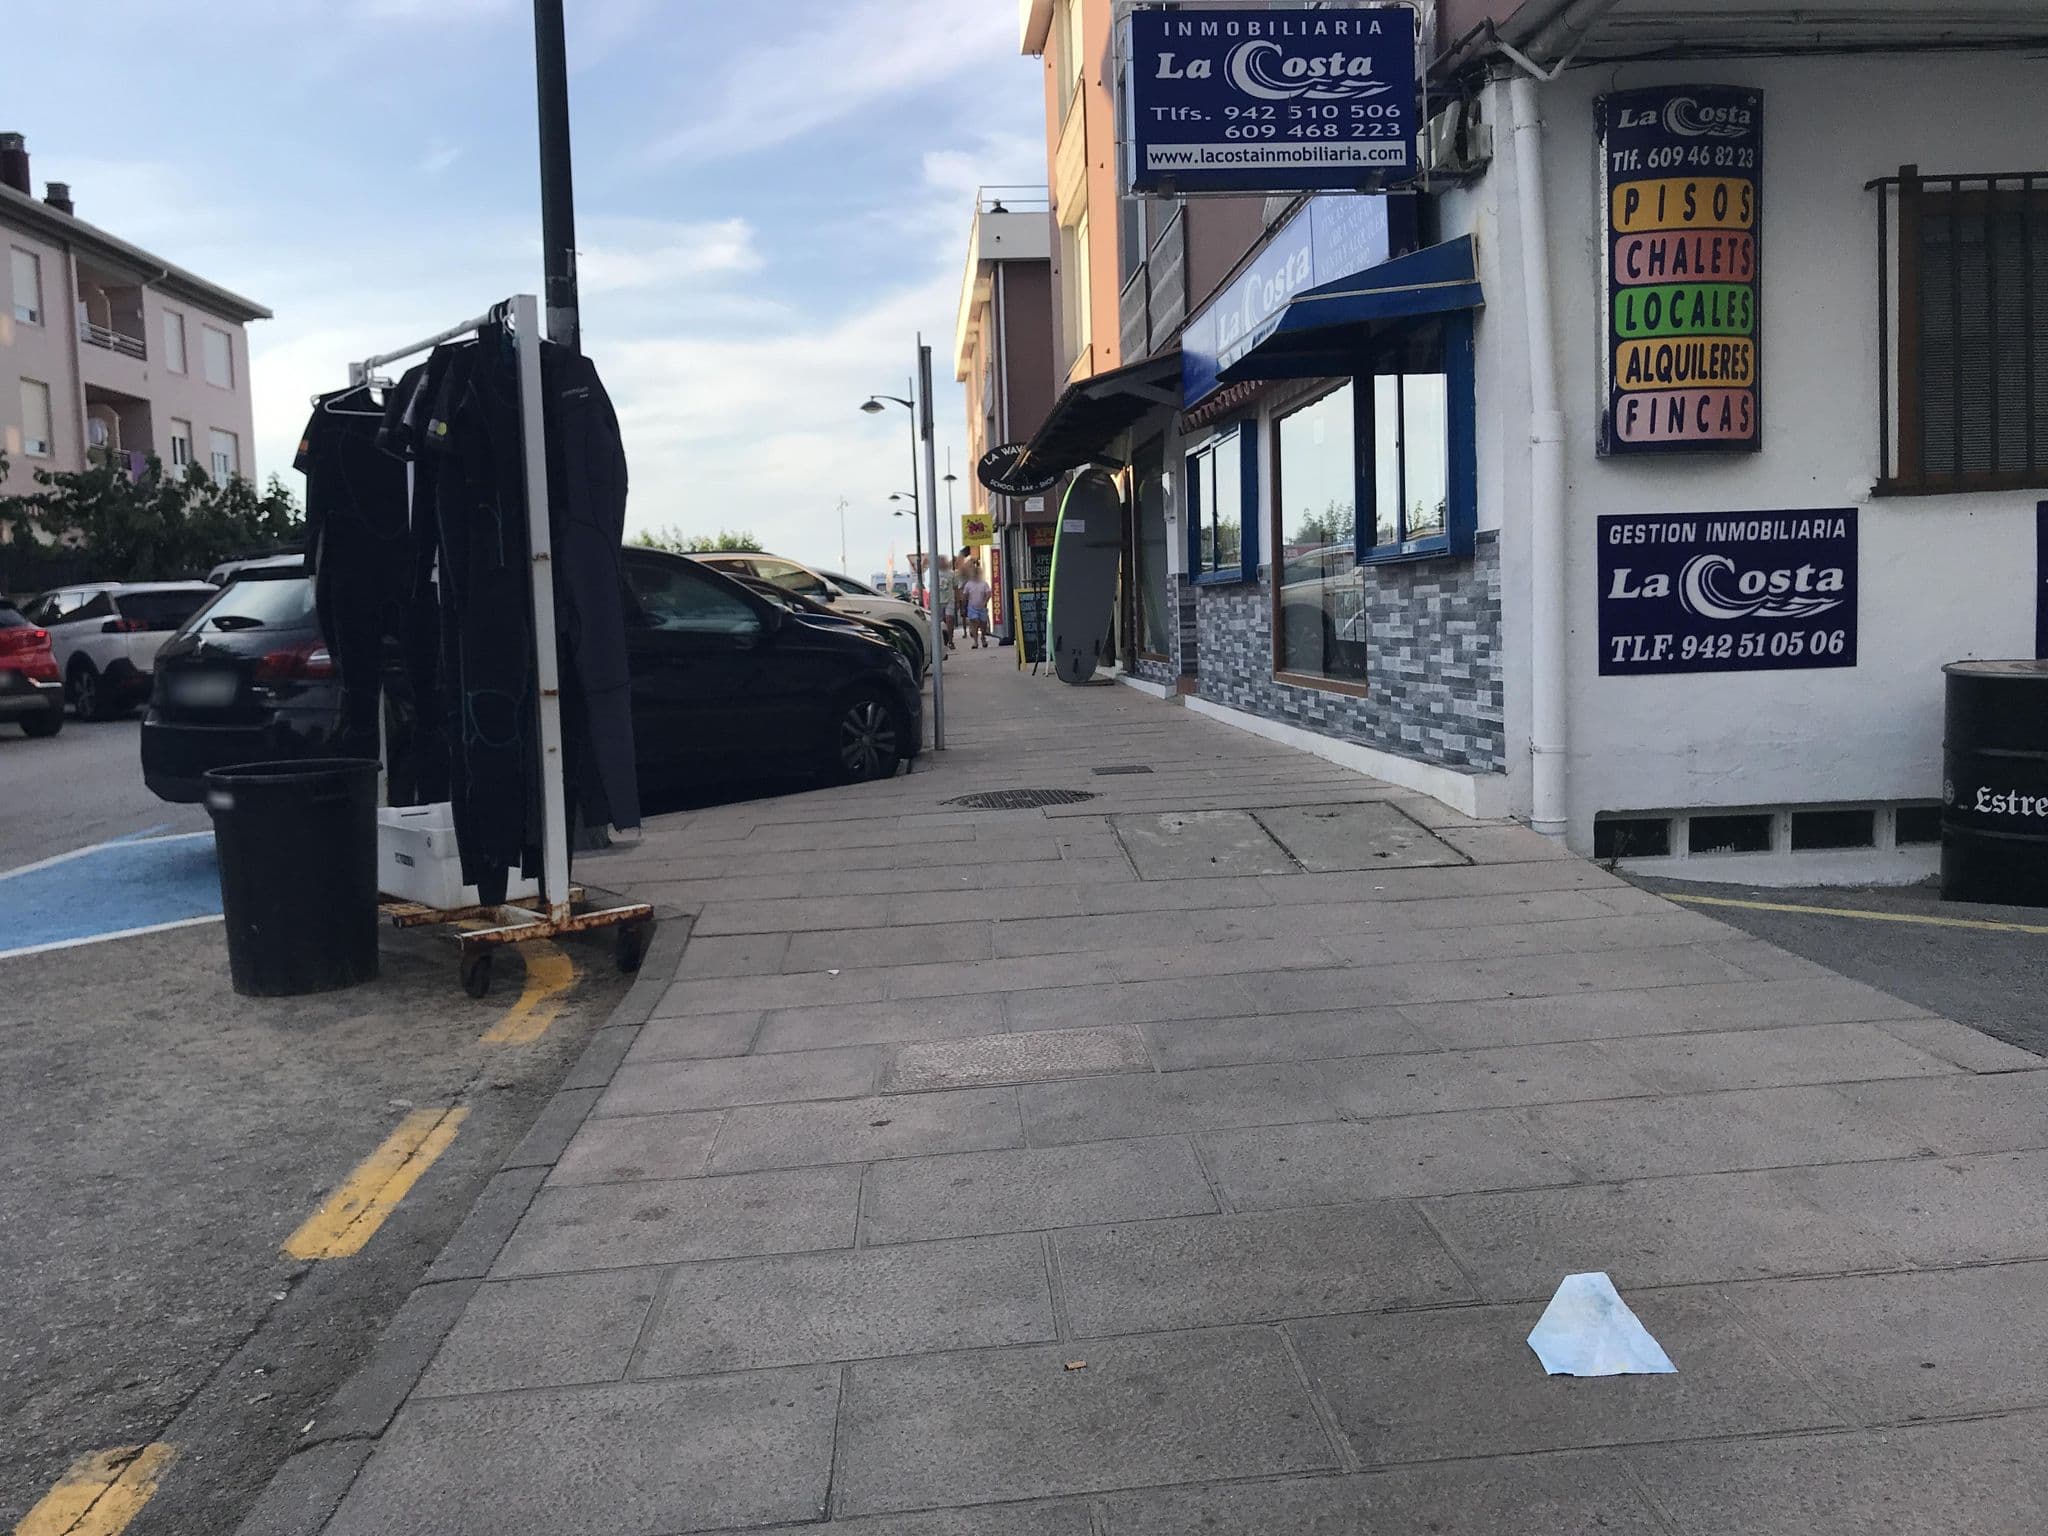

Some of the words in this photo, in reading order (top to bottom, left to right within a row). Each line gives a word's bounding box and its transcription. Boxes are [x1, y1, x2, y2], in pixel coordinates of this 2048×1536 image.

[1164, 20, 1383, 36] INMOBILIARIA
[1155, 52, 1212, 79] La
[1224, 39, 1388, 100] Costa
[1150, 106, 1212, 121] Tlfs.
[1224, 106, 1277, 120] 942
[1288, 105, 1339, 119] 510
[1350, 103, 1401, 118] 506
[1224, 124, 1277, 138] 609
[1287, 123, 1339, 138] 468
[1350, 122, 1401, 137] 223
[1617, 109, 1658, 130] La
[1662, 97, 1752, 137] Costa
[1149, 148, 1403, 164] www.lacostainmobiliaria.com
[1612, 151, 1642, 173] Tlf.
[1647, 147, 1684, 169] 609
[1687, 146, 1710, 167] 46
[1714, 145, 1734, 167] 82
[1625, 182, 1751, 226] PISOS
[1626, 236, 1751, 279] CHALETS
[1625, 290, 1751, 332] LOCALES
[1625, 342, 1750, 385] ALQUILERES
[1625, 393, 1750, 436] FINCAS
[984, 453, 1000, 466] LA
[1608, 523, 1698, 545] GESTION
[1705, 518, 1847, 543] INMOBILIARIA
[1607, 567, 1671, 600] La
[1677, 553, 1846, 620] Costa
[1610, 634, 1674, 663] TLF.
[1680, 633, 1733, 661] 942
[1808, 629, 1846, 655] 06
